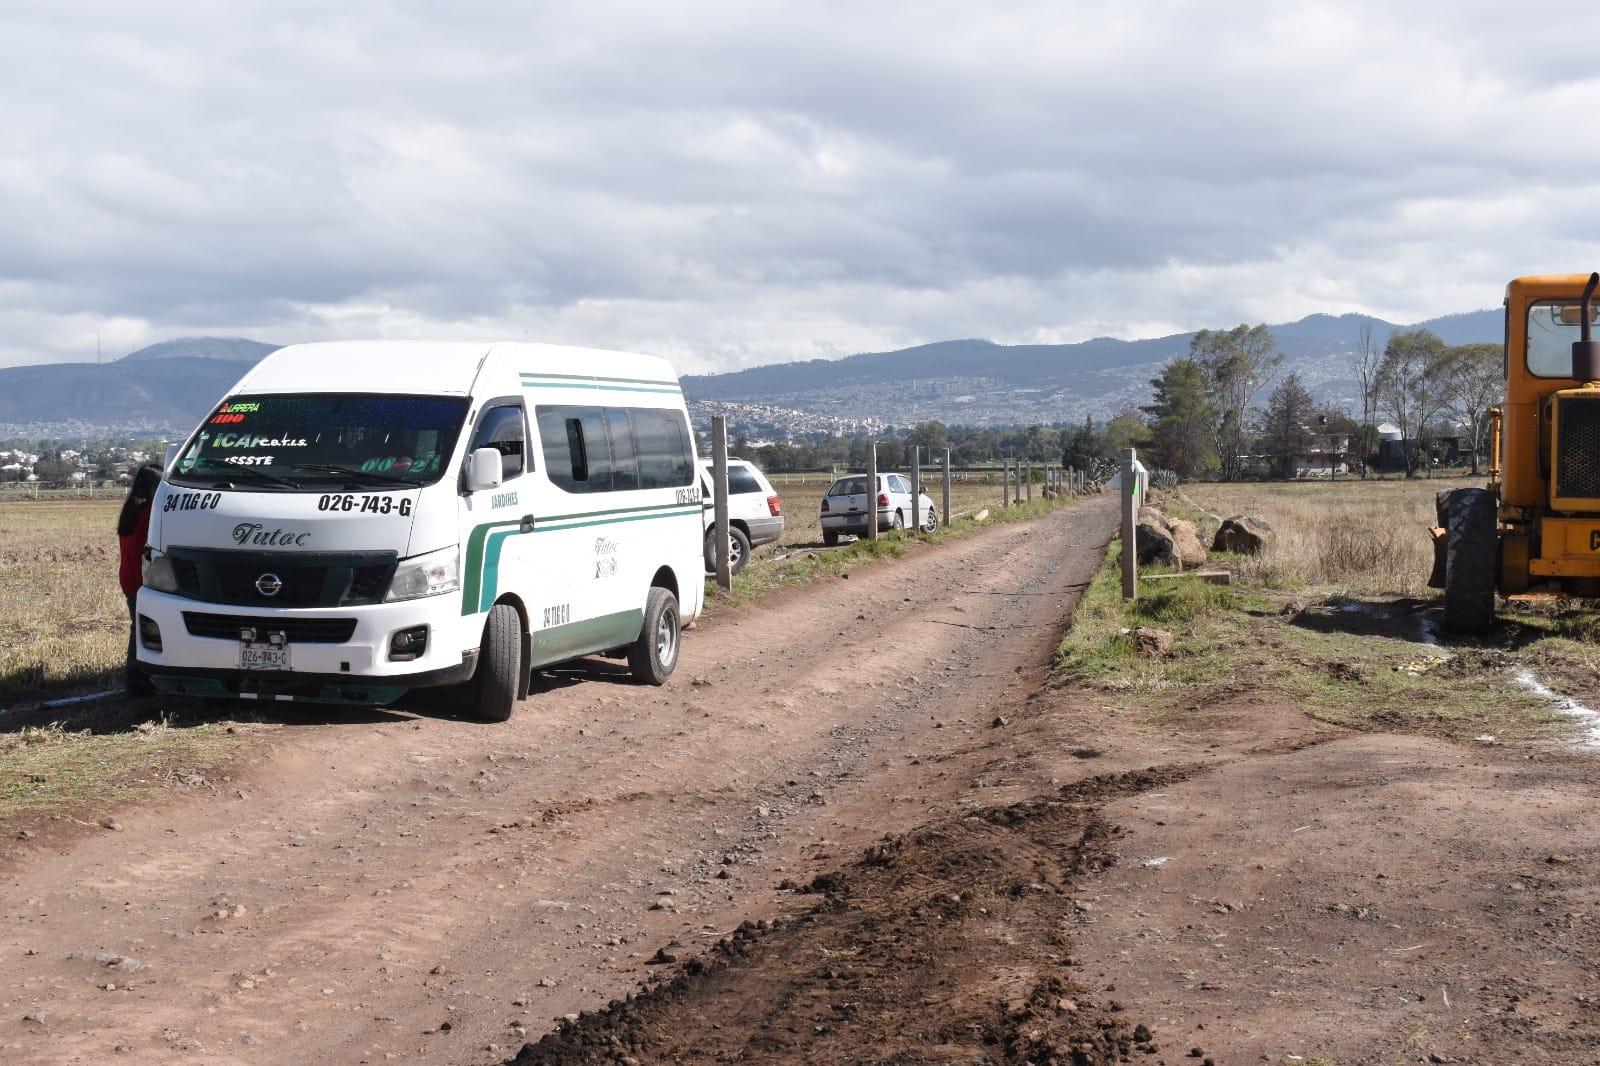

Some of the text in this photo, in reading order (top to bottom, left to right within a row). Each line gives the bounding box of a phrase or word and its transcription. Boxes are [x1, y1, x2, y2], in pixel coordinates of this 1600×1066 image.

[163, 494, 181, 512] 34
[179, 492, 201, 511] TLG
[317, 494, 412, 517] 026-743-G
[491, 490, 519, 510] JARDINES
[232, 523, 311, 547] Tutac
[242, 649, 287, 663] 026-743-G
